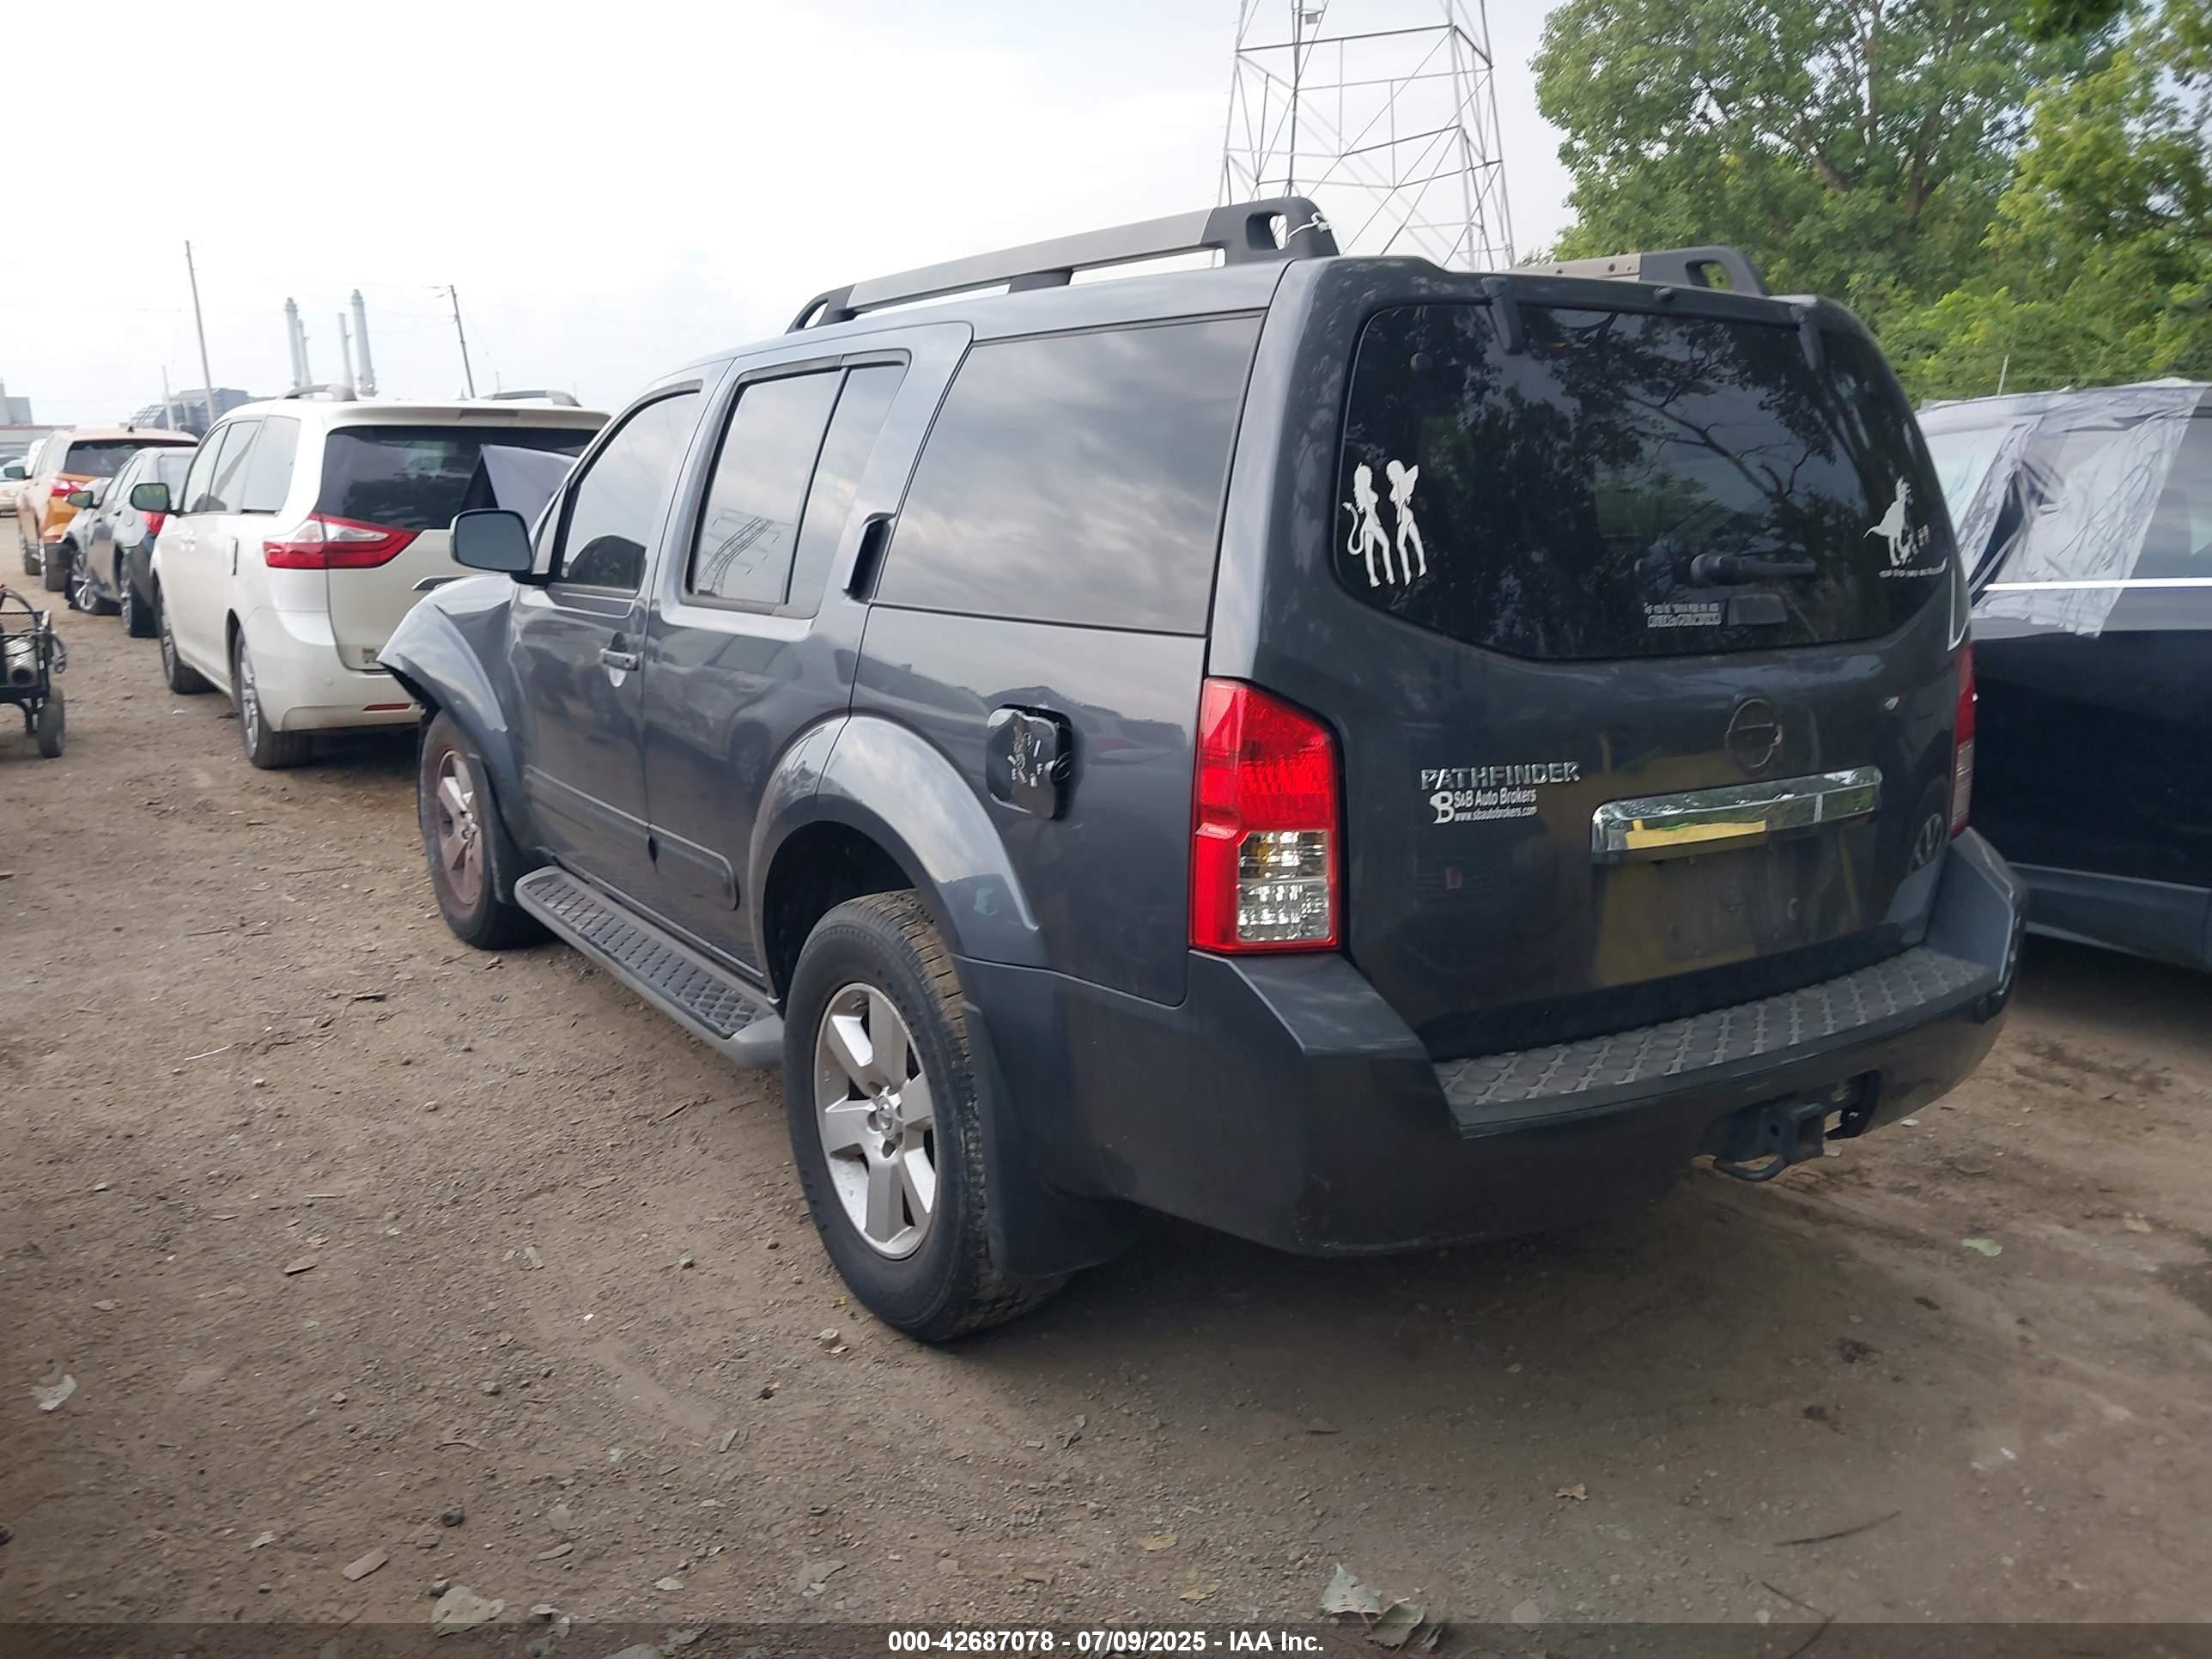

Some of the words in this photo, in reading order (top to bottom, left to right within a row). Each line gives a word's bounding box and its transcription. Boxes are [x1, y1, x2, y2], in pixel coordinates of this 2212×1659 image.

[1420, 762, 1581, 790] PATHFINDER
[1454, 789, 1474, 808] S&B
[1474, 789, 1498, 807] Auto
[1499, 787, 1537, 805] Brokers
